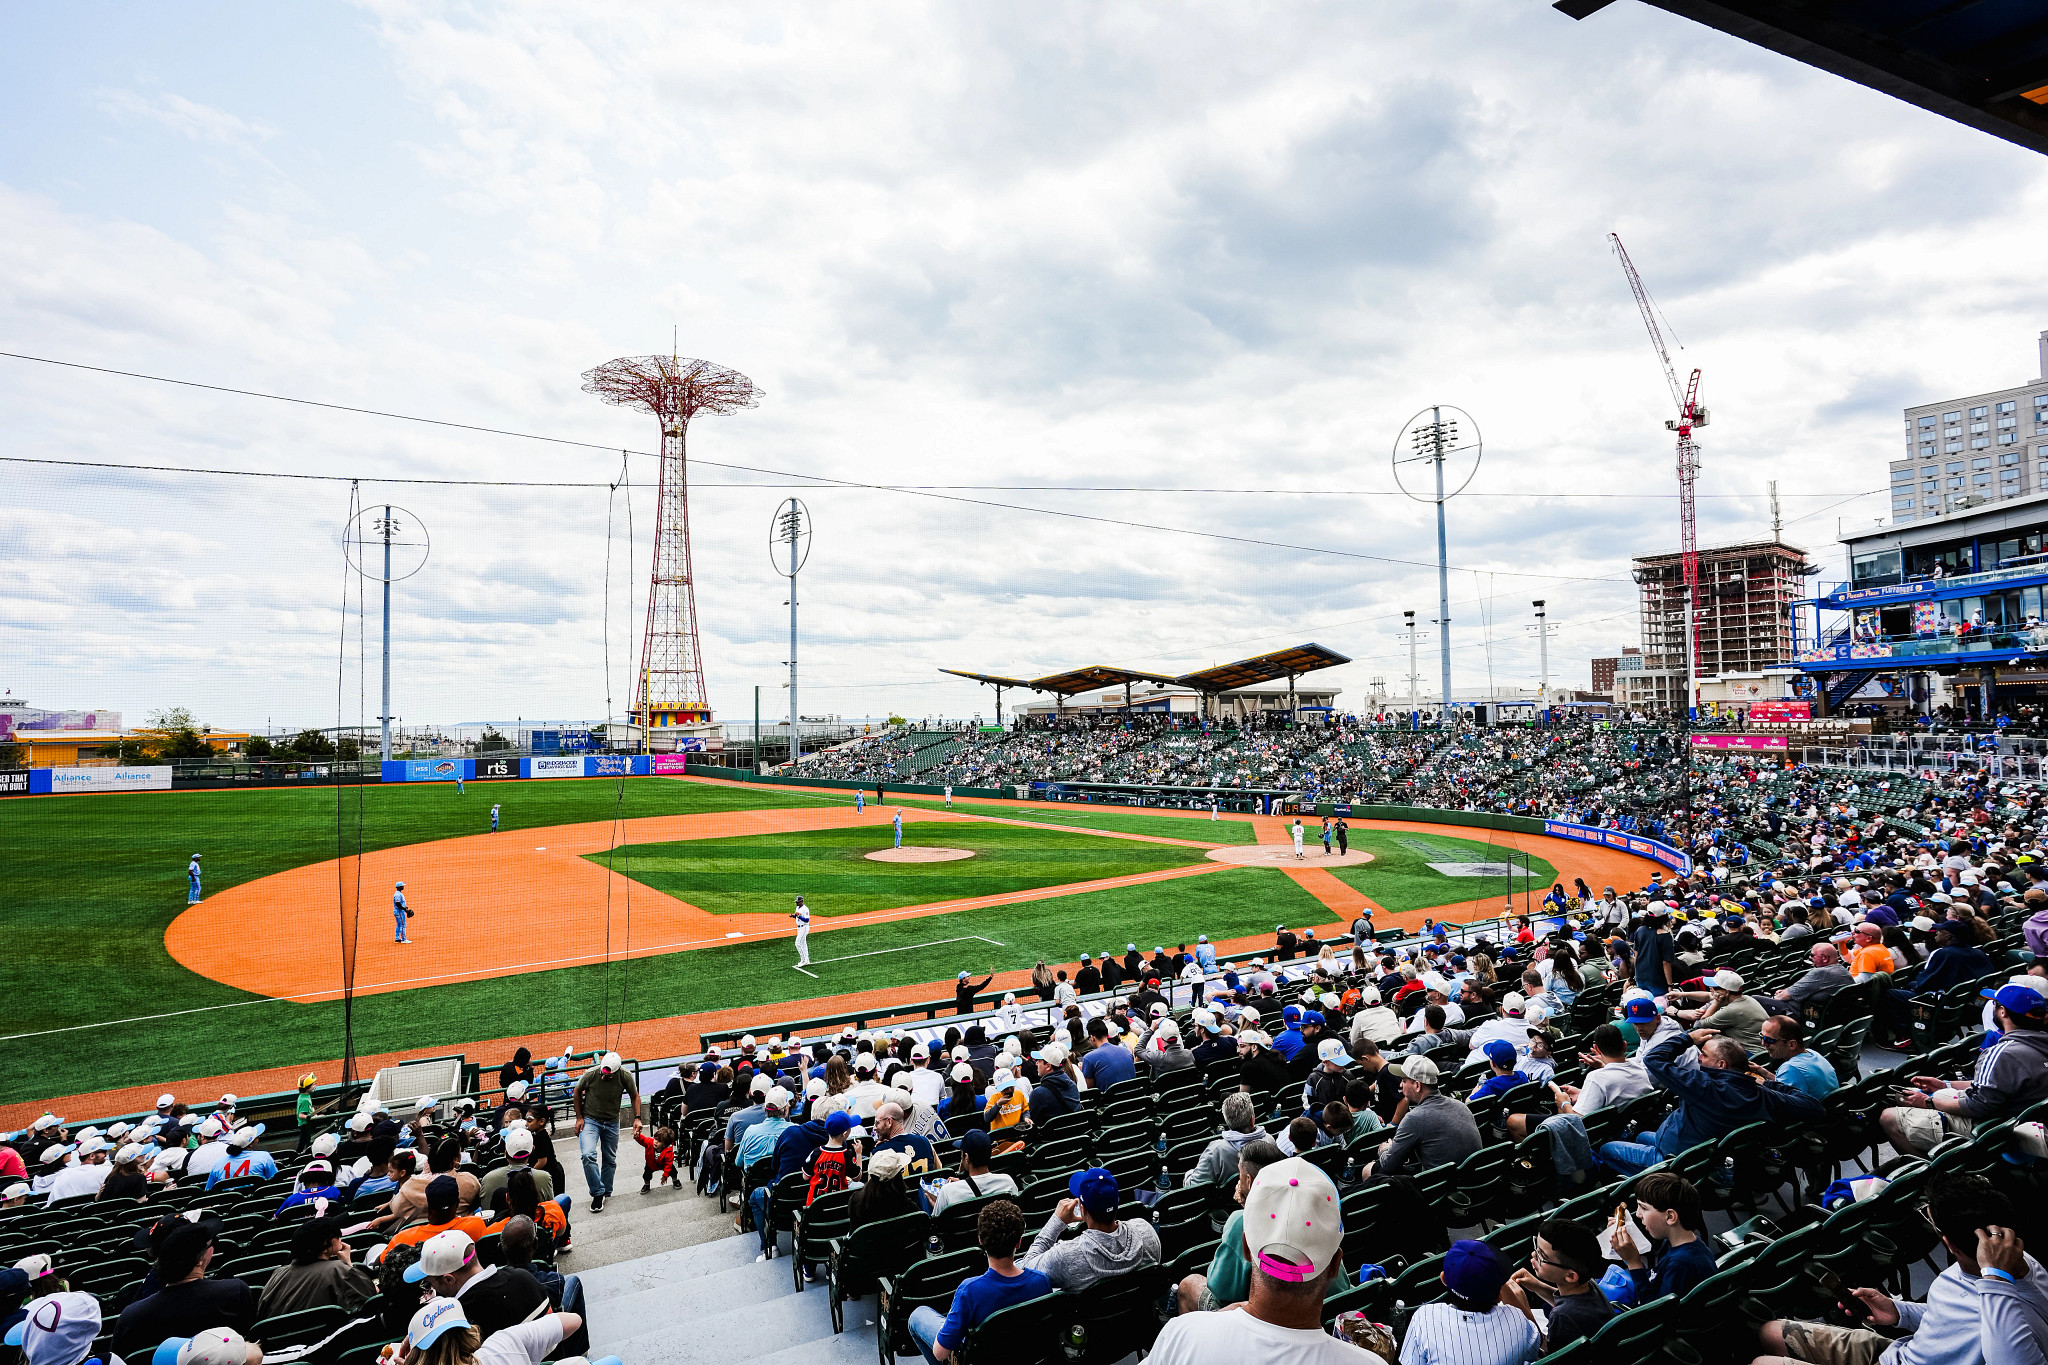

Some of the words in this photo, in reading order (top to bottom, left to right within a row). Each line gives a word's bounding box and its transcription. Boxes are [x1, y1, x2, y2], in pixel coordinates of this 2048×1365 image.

[487, 762, 508, 775] rts
[11, 773, 28, 783] THAT
[53, 773, 92, 782] Alliance
[114, 772, 152, 780] Alliance
[9, 782, 27, 791] BUILT
[1010, 1014, 1017, 1024] 7
[224, 1159, 251, 1179] 14
[423, 1303, 456, 1329] Cyclones
